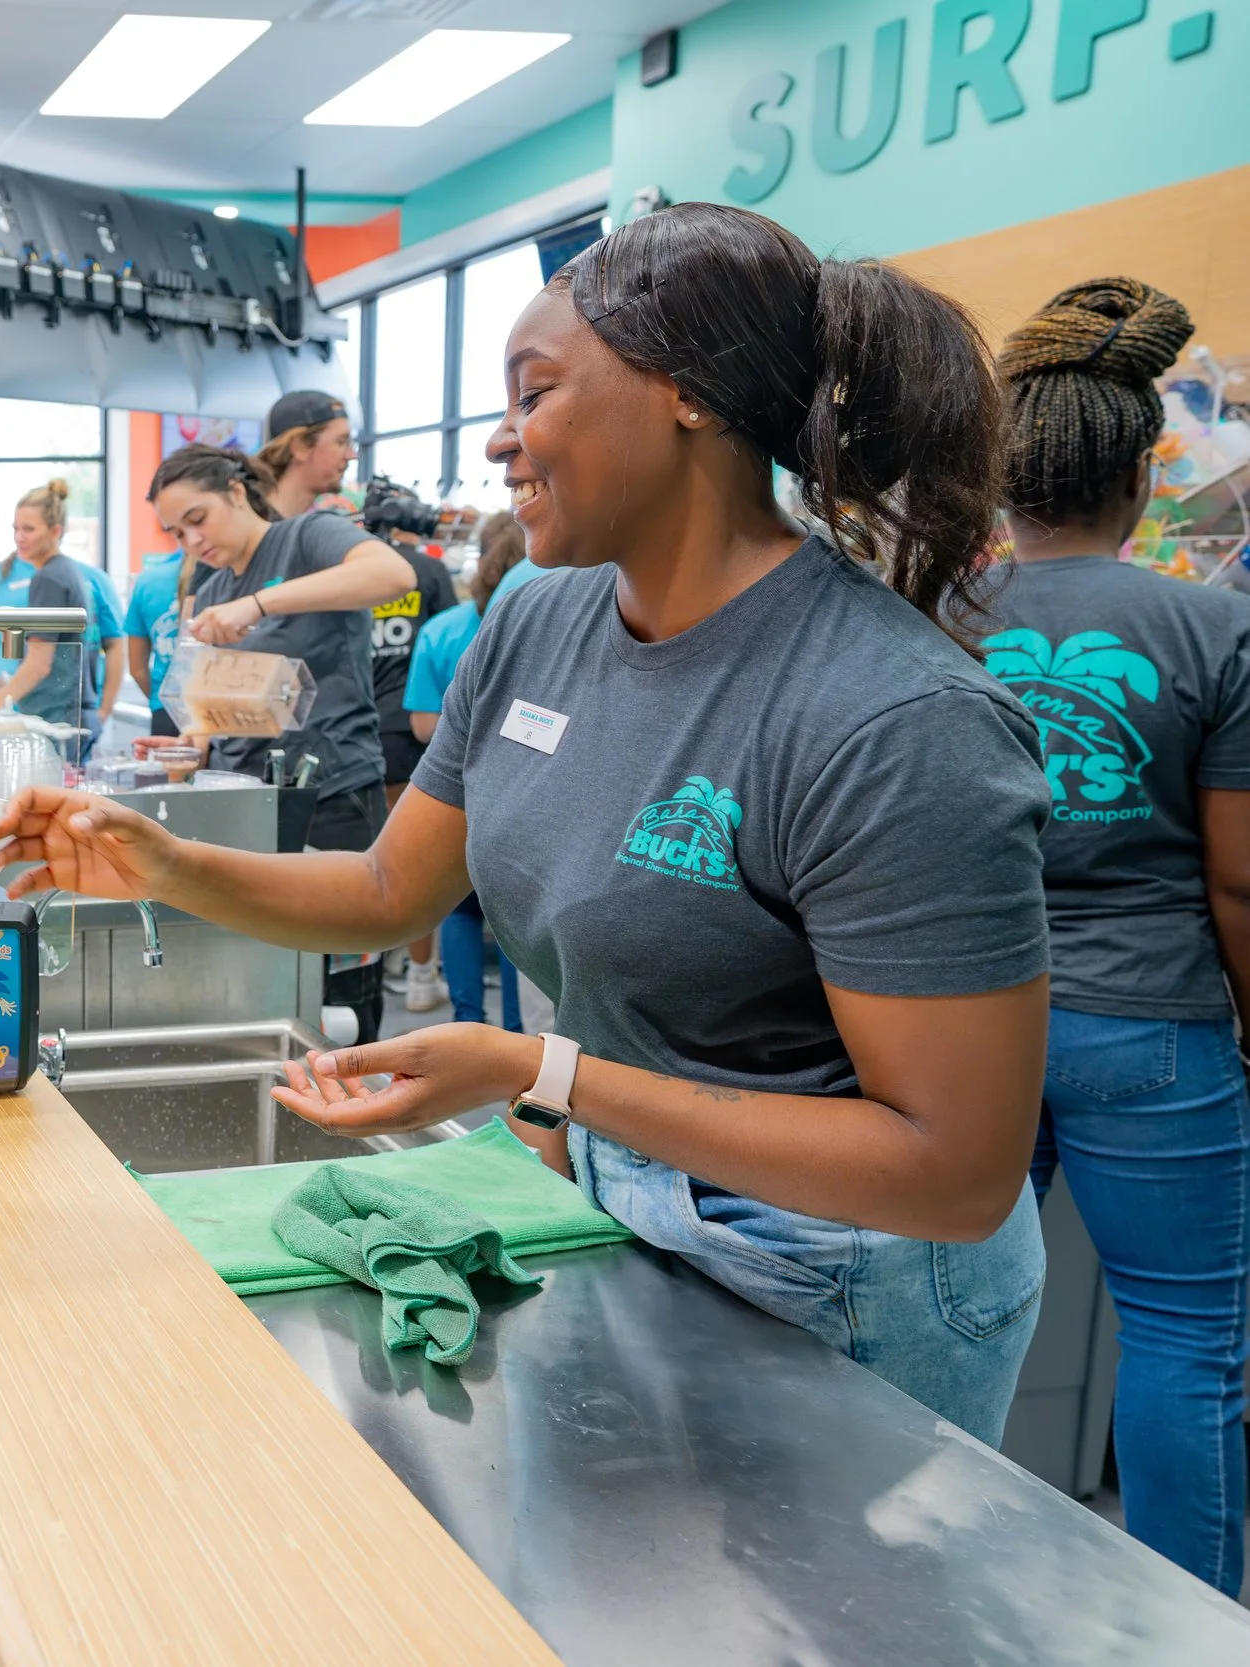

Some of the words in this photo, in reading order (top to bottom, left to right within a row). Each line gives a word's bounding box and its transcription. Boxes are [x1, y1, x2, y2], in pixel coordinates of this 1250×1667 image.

[1053, 805, 1153, 825] Company
[628, 827, 727, 877] BUCK'S
[645, 861, 677, 877] Shaved
[677, 869, 691, 881] Ice
[693, 874, 740, 892] Company
